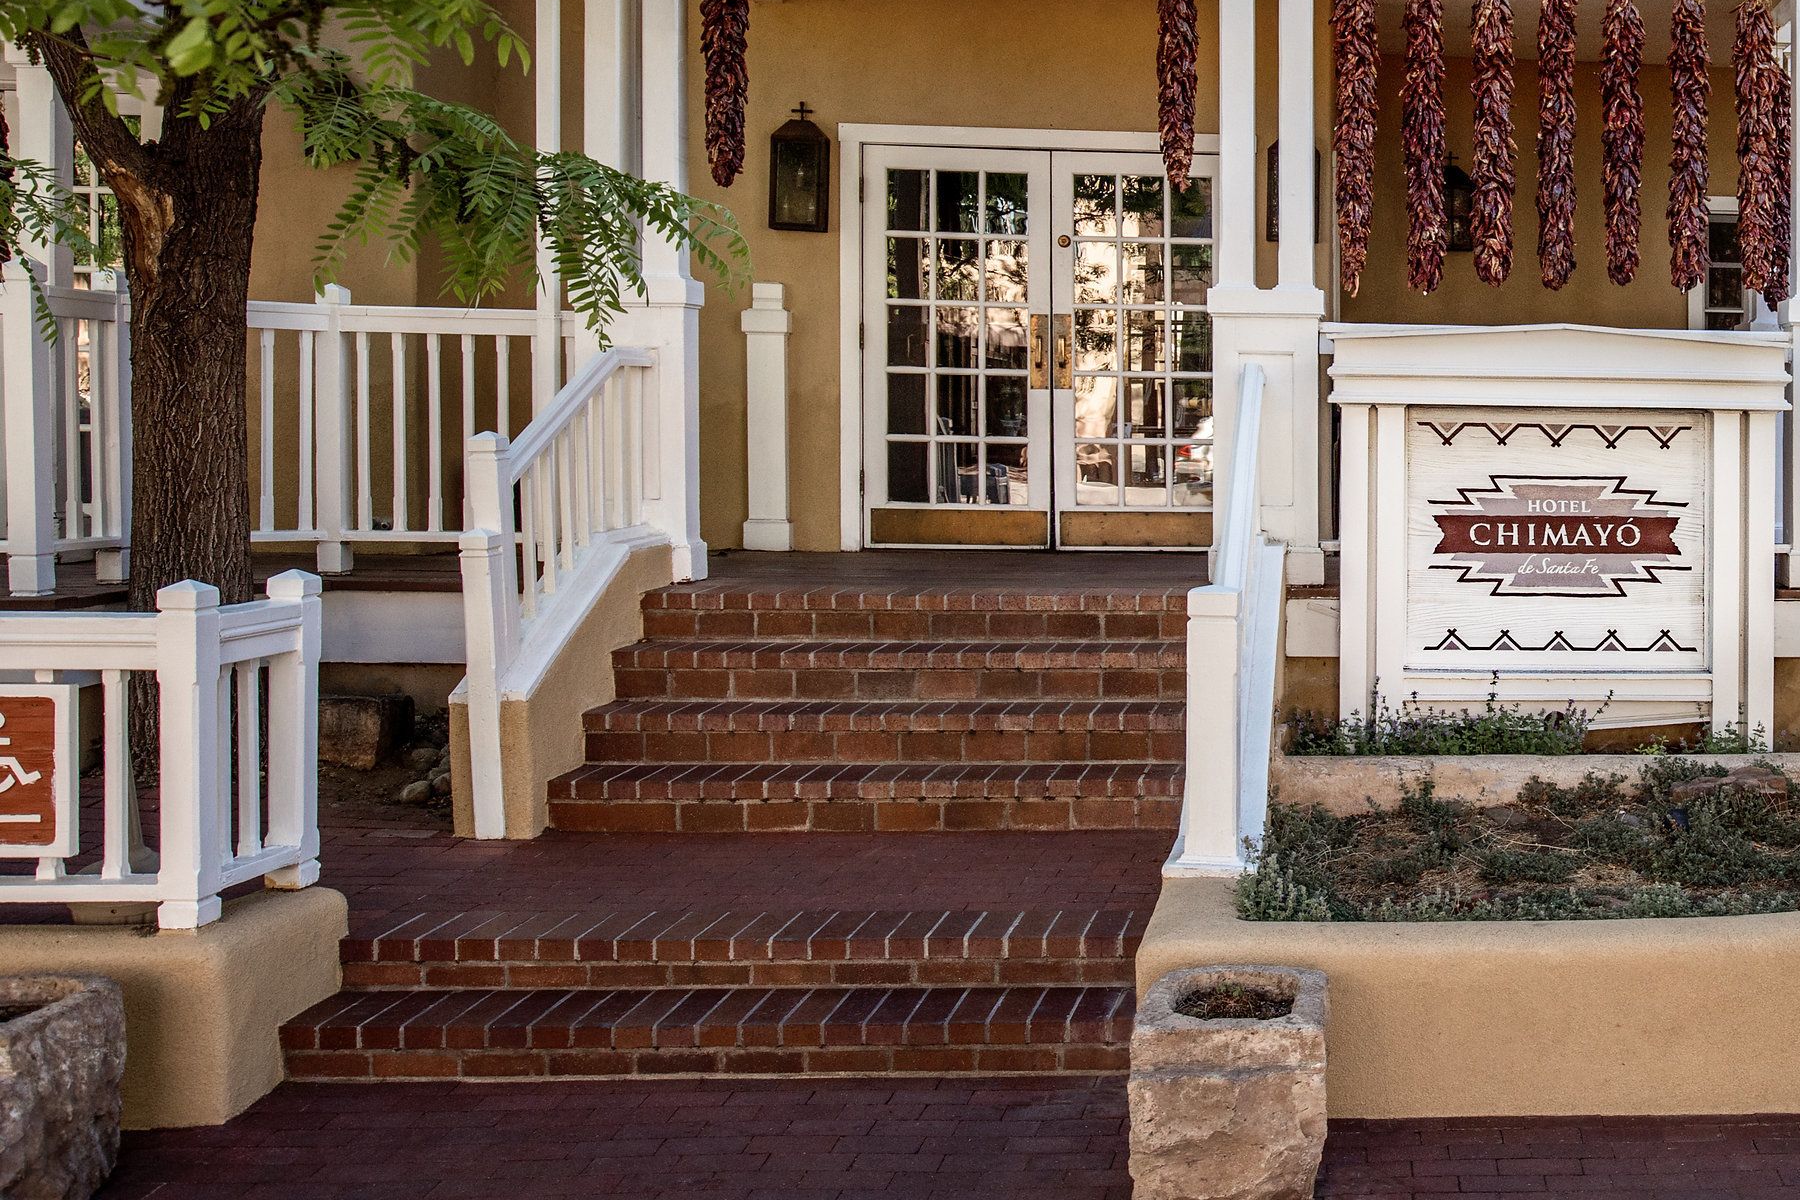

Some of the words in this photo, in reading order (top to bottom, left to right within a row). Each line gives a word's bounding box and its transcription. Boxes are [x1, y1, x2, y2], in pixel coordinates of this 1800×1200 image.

[1527, 499, 1591, 513] HOTEL
[1469, 517, 1641, 547] CHIMAYÓ
[1517, 553, 1537, 575] de
[1536, 557, 1580, 574] Santa
[1580, 558, 1600, 574] Fe
